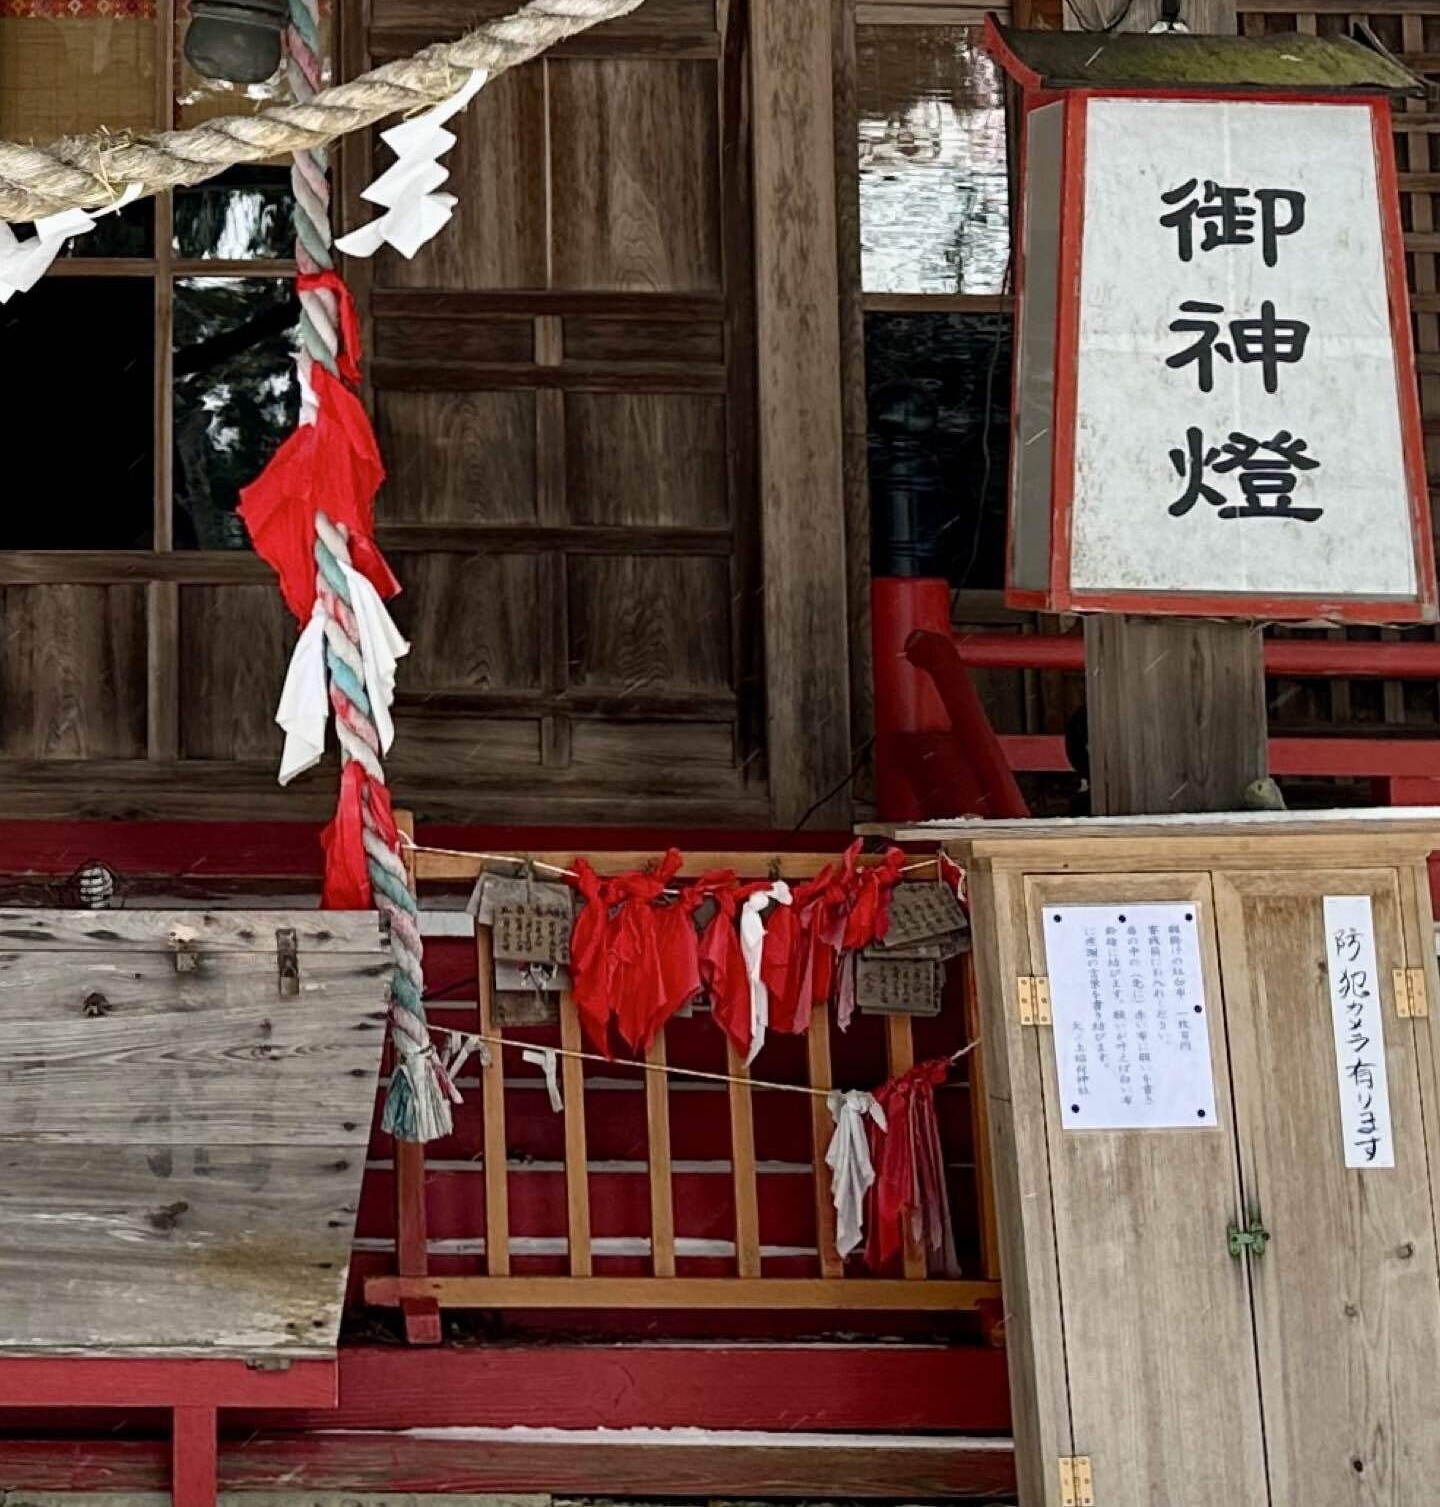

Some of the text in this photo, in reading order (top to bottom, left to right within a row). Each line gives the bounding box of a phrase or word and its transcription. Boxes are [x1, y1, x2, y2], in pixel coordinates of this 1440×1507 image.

[1159, 178, 1324, 523] 御神燈
[1333, 927, 1383, 1163] 防犯カメラ有ります
